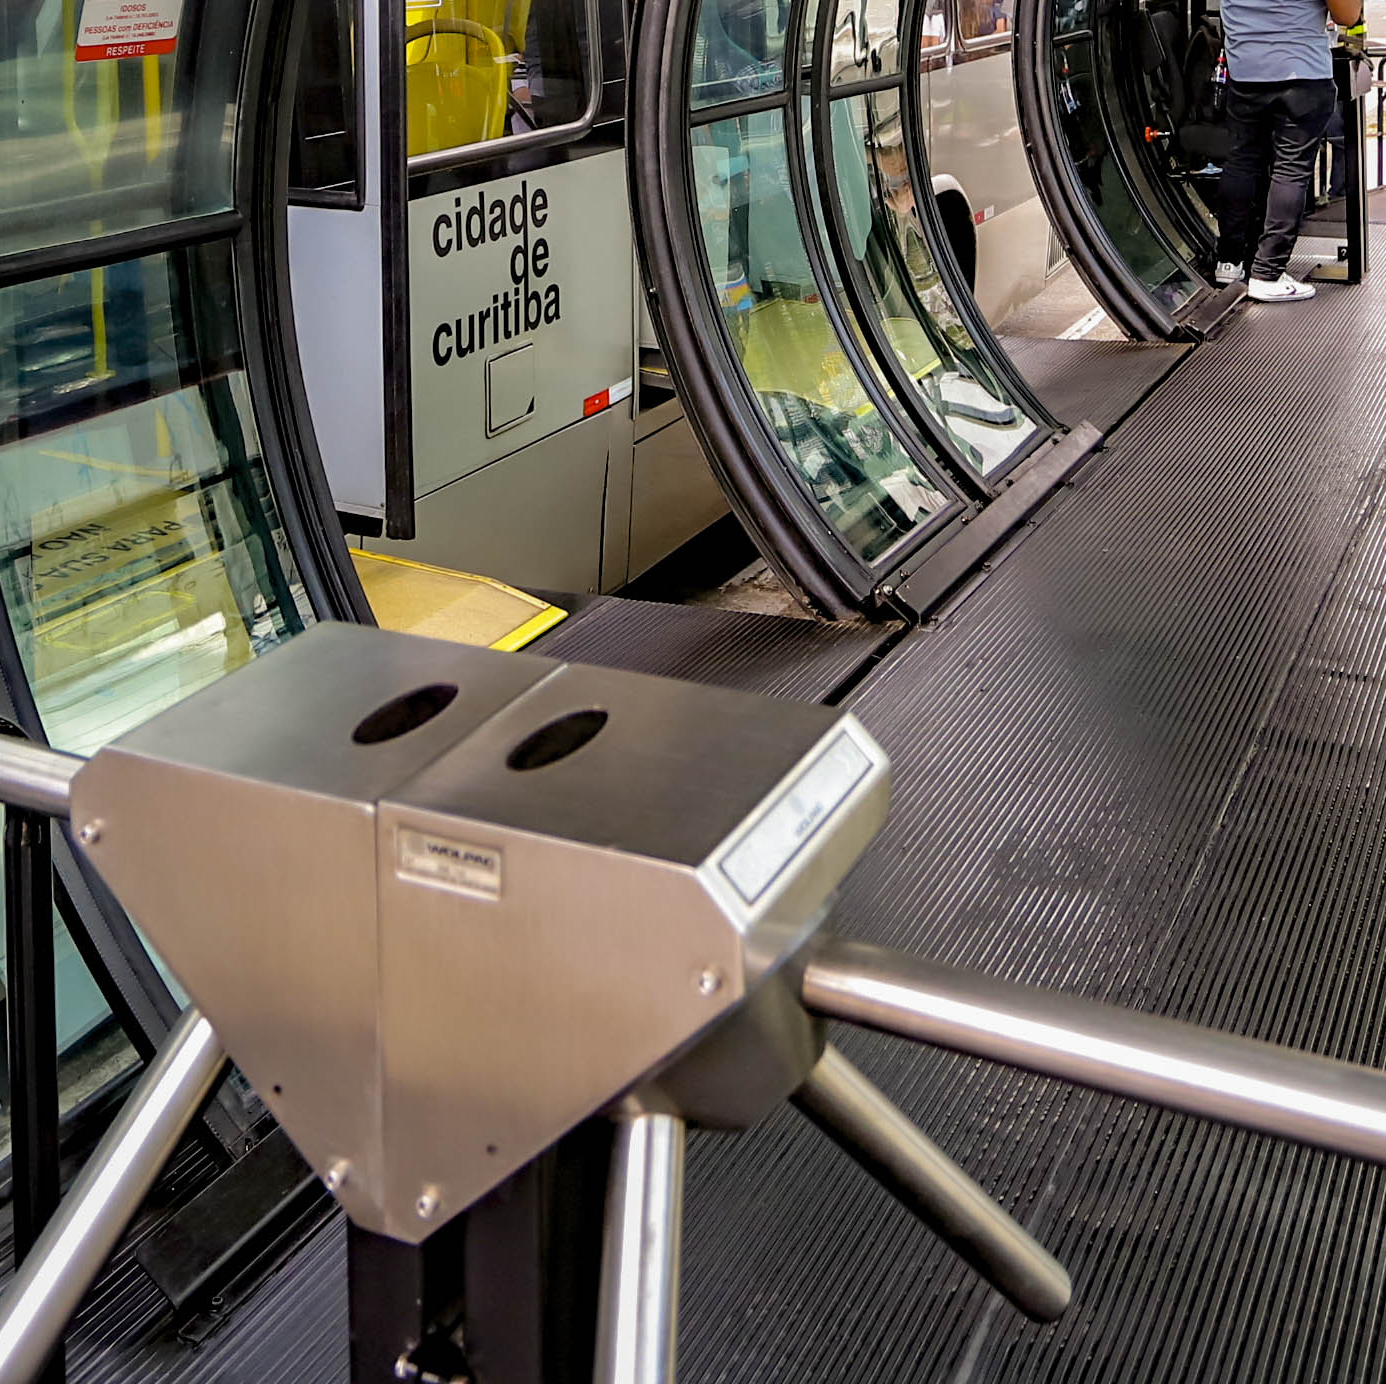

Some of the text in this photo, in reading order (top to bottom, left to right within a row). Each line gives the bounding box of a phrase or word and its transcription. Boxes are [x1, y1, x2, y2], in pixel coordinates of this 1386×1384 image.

[120, 4, 147, 12] IDOSOS
[84, 26, 117, 34] PESSOAS
[133, 20, 173, 31] DEFICIÊNCIA
[106, 44, 145, 56] RESPEITE
[433, 180, 549, 258] cidade
[510, 235, 550, 286] de
[432, 282, 561, 367] curitiba
